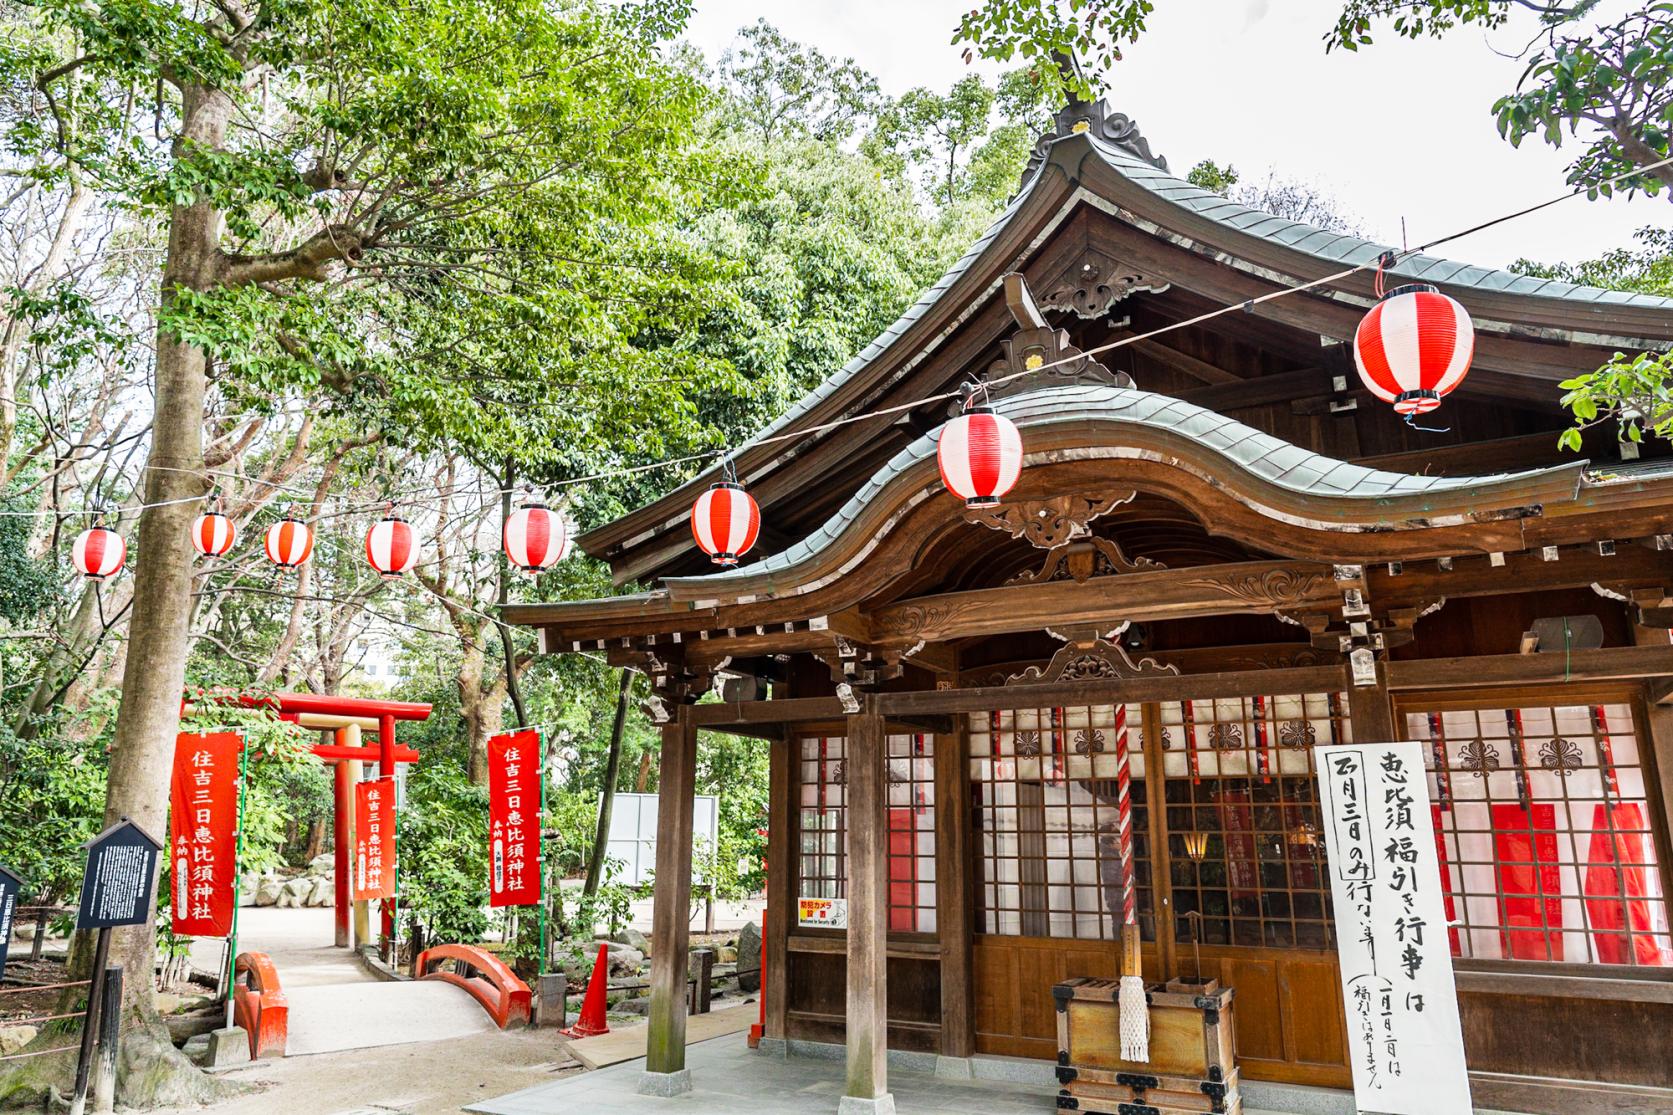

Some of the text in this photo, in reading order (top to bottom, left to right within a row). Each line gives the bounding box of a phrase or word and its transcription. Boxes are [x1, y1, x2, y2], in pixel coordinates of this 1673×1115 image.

[192, 751, 215, 919] 住吉三日恵比須神社
[368, 789, 382, 890] 住吉三日恵比須神社
[503, 747, 525, 891] 住吉三日恵比須神社
